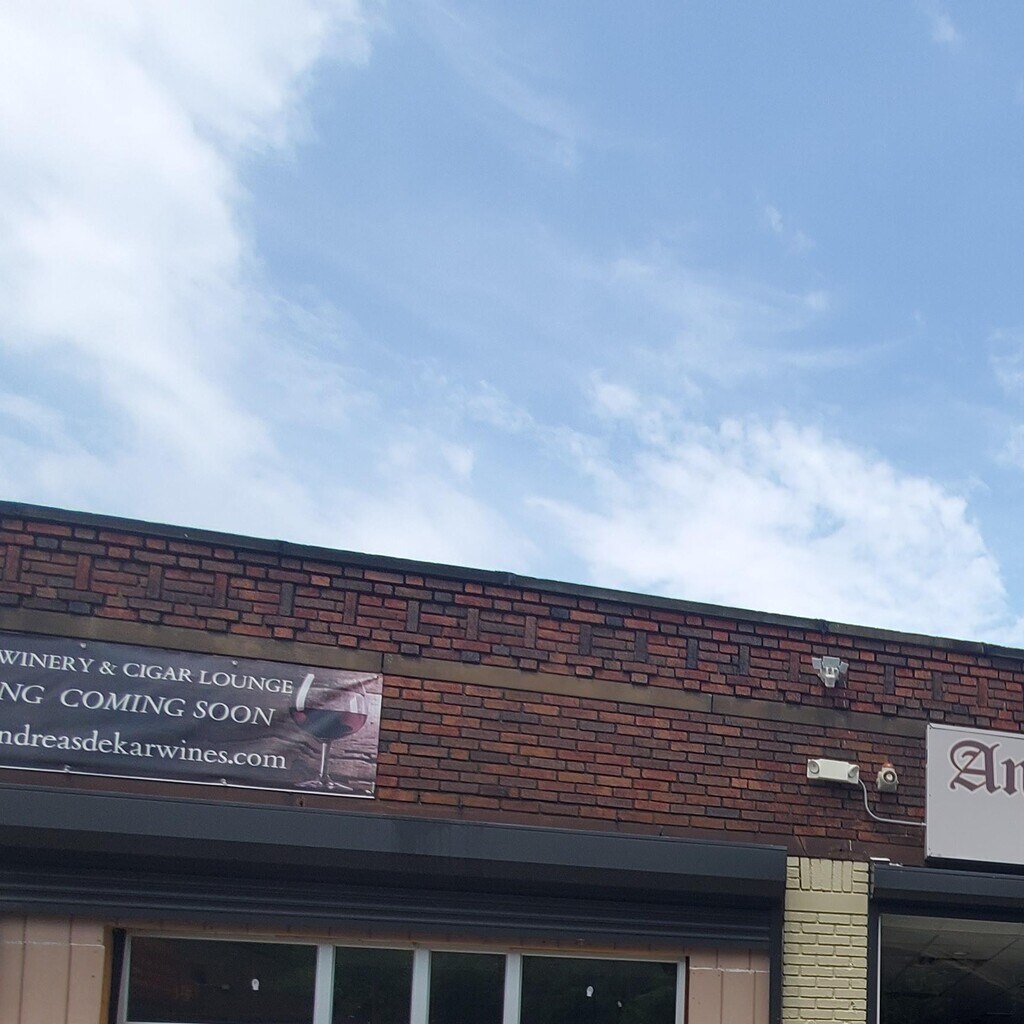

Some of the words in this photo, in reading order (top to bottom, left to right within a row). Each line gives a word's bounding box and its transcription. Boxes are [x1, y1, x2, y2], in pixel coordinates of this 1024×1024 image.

[0, 649, 95, 673] WINERY
[99, 660, 119, 675] &
[122, 662, 193, 683] CIGAR
[199, 670, 293, 695] LOUNGE
[60, 688, 186, 717] COMING
[192, 700, 276, 727] SOON
